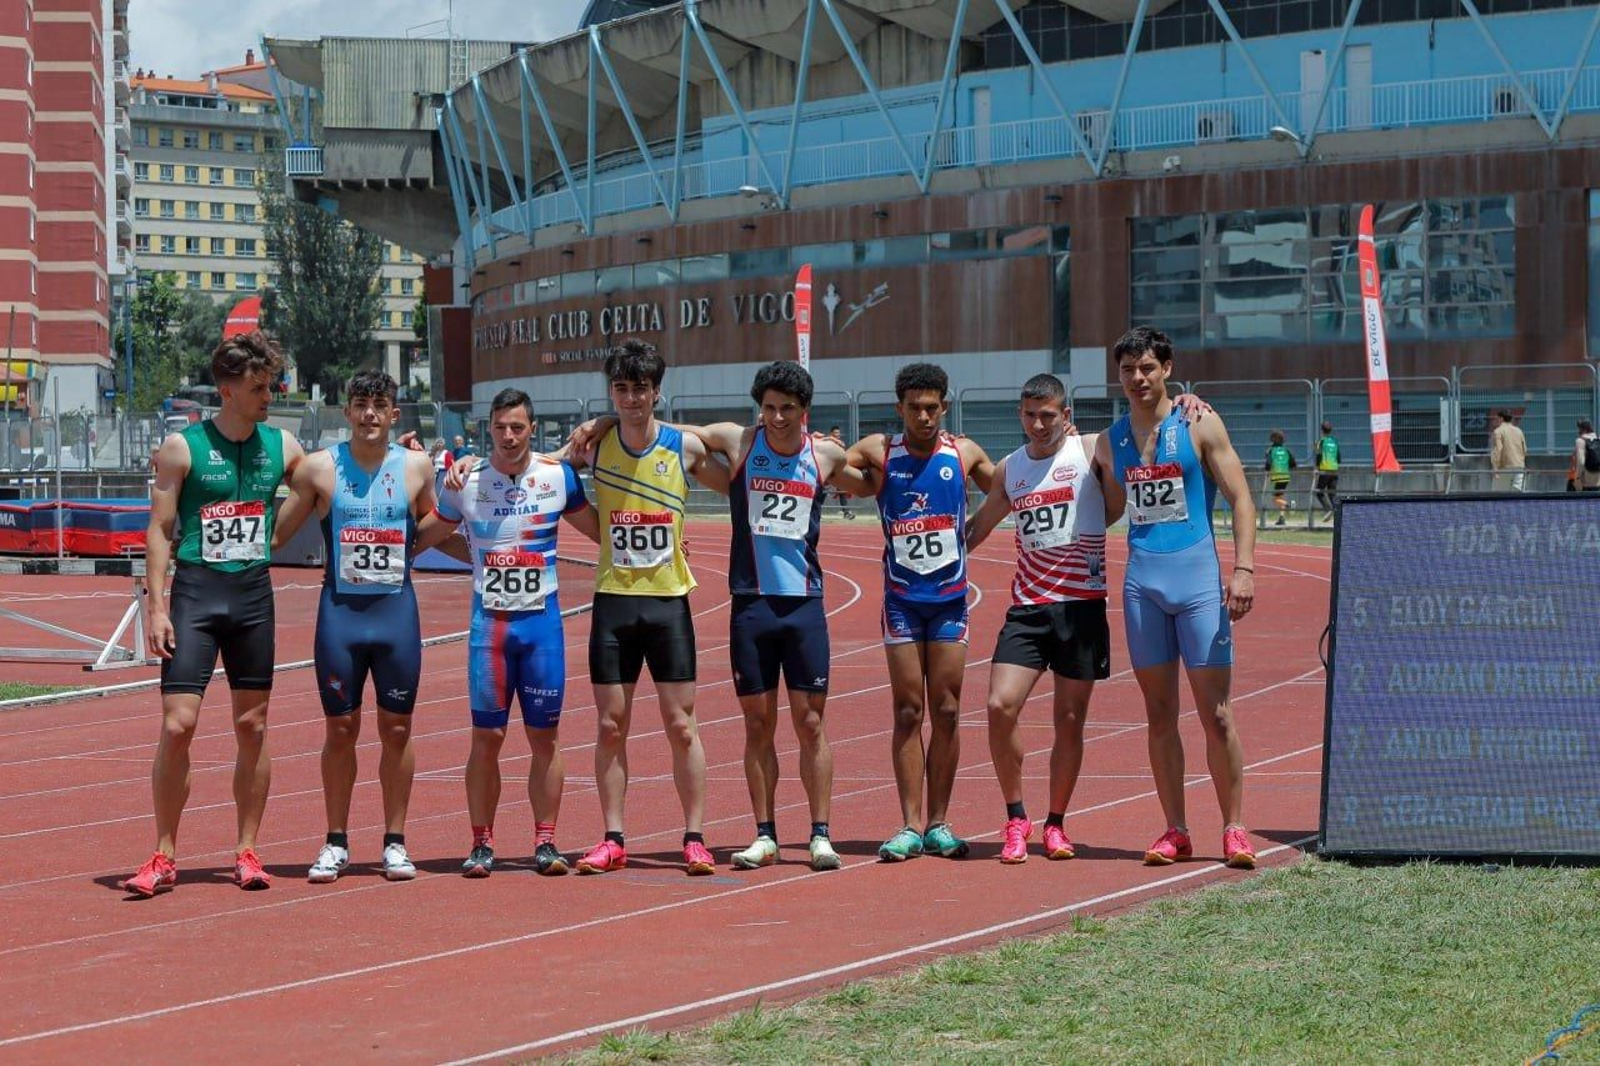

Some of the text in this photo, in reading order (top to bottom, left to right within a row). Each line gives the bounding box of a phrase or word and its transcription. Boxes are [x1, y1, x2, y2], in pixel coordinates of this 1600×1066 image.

[511, 317, 541, 346] REAL
[548, 309, 589, 341] CLUB
[600, 302, 661, 336] CELTA
[680, 298, 711, 329] DE
[732, 291, 796, 325] VIGO
[753, 479, 785, 492] VIGO
[1126, 469, 1153, 481] VIGO
[1014, 494, 1042, 509] VIGO
[1131, 480, 1176, 508] 132
[204, 504, 235, 518] VIGO
[612, 512, 641, 524] VIGO
[762, 493, 798, 522] 22
[1019, 503, 1069, 536] 297
[206, 516, 260, 546] 347
[343, 530, 376, 543] VIGO
[612, 525, 668, 551] 360
[893, 520, 925, 534] VIGO
[1441, 522, 1498, 556] 100
[1509, 522, 1537, 556] M
[353, 544, 390, 571] 33
[906, 531, 943, 561] 26
[486, 554, 516, 566] VIGO
[486, 567, 541, 595] 268
